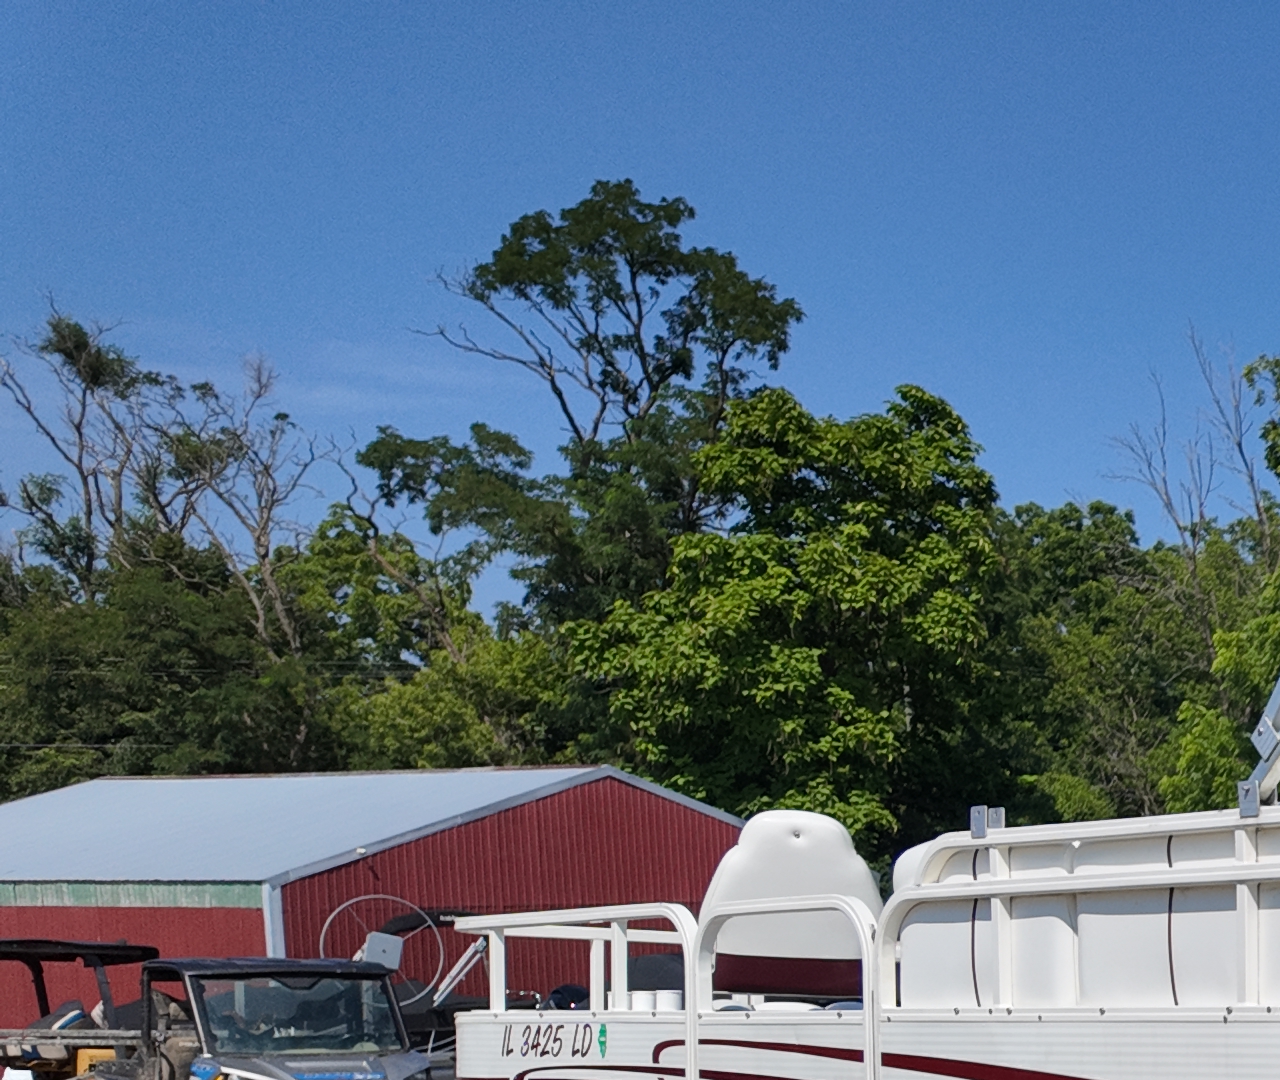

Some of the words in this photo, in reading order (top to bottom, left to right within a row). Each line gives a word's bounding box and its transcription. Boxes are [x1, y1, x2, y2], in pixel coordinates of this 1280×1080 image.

[501, 1024, 514, 1057] IL
[520, 1024, 565, 1058] 3425
[571, 1023, 593, 1058] LD
